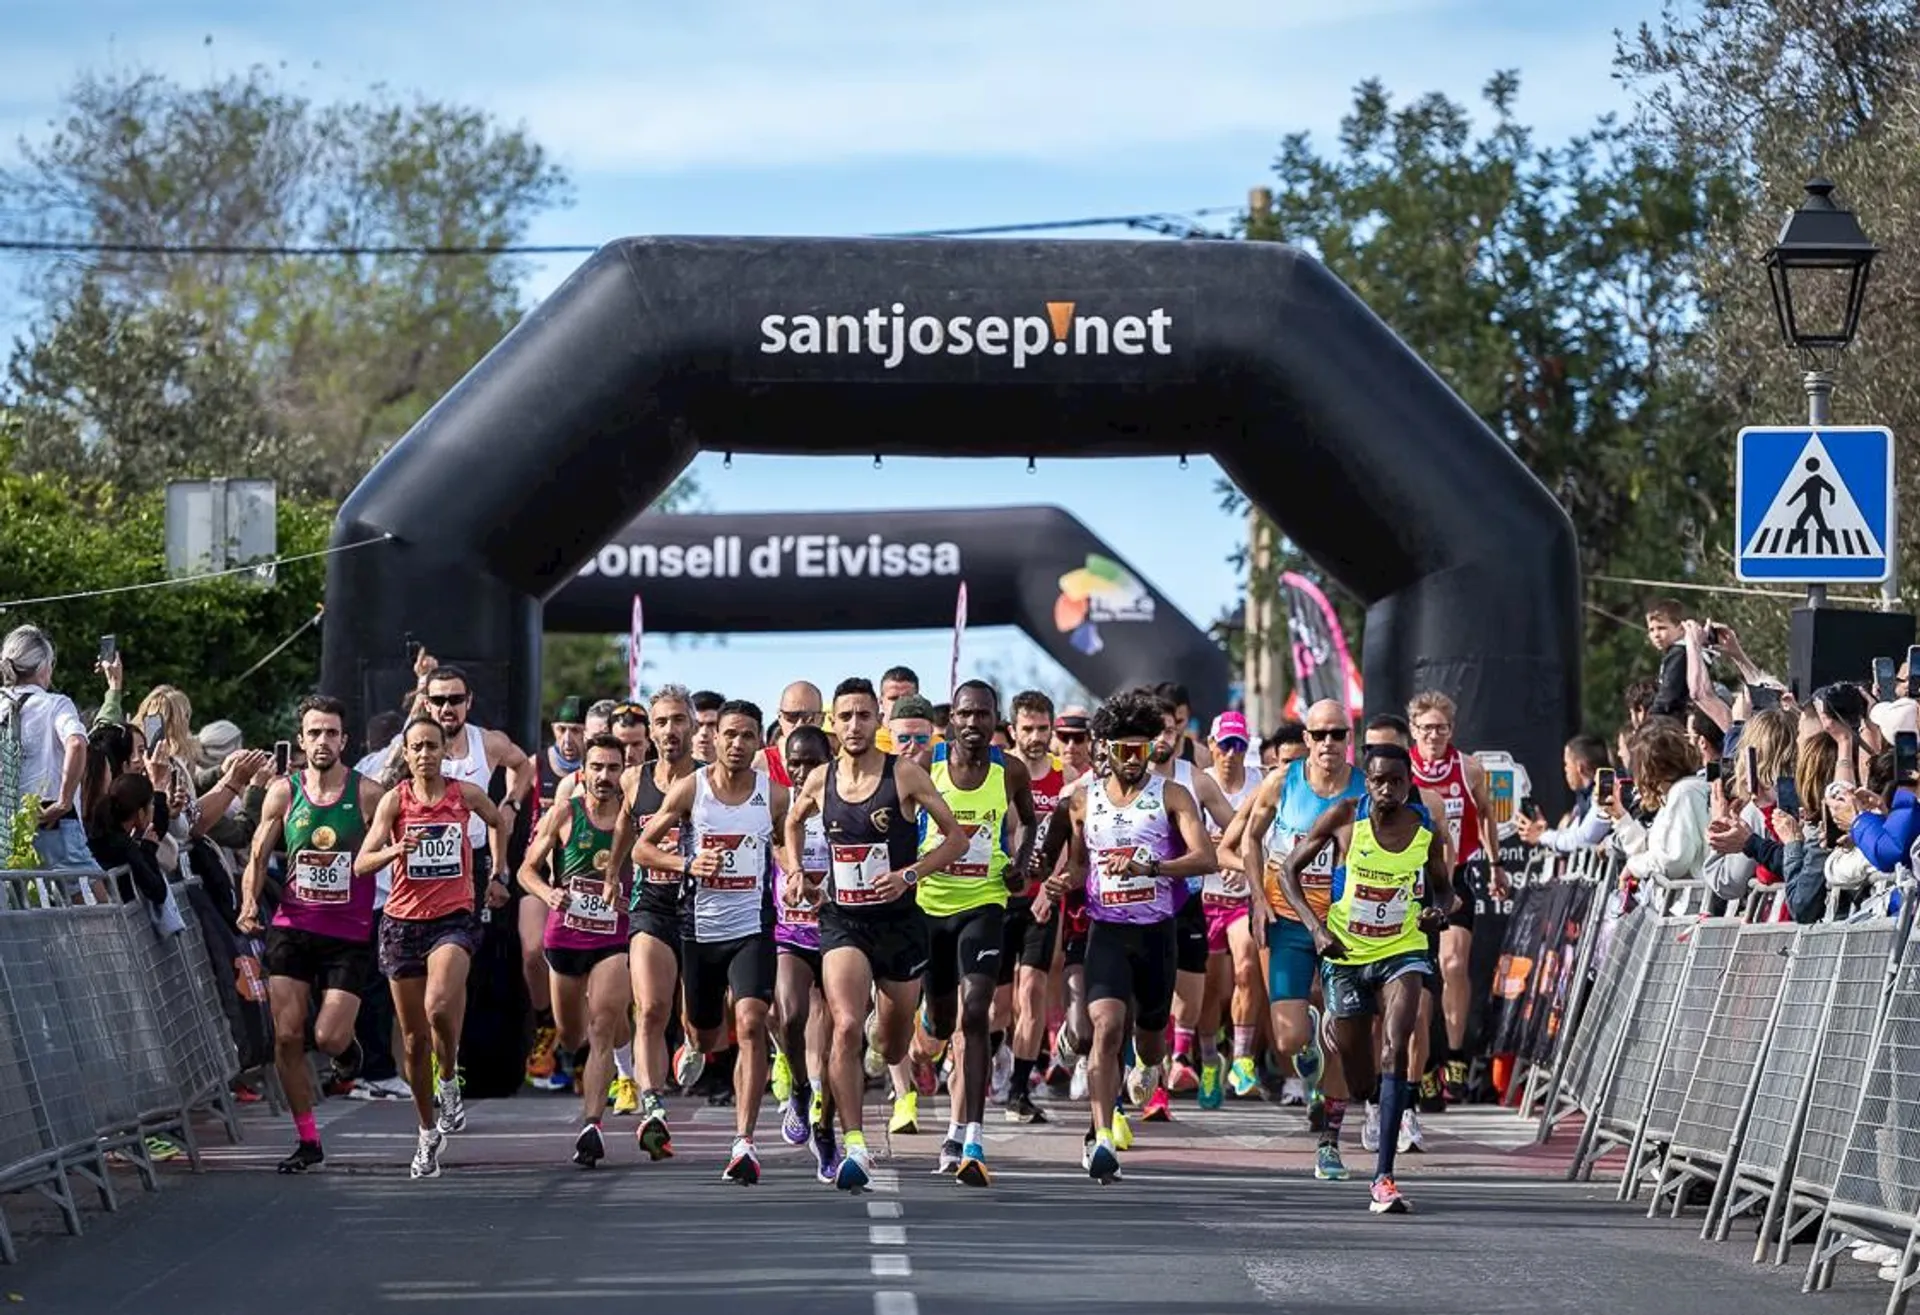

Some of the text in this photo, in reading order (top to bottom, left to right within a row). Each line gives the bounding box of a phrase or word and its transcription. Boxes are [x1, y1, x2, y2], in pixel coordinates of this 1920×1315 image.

[749, 534, 960, 578] d'Eivissa
[417, 840, 454, 858] 1002
[725, 851, 735, 868] 3
[309, 866, 338, 883] 386
[854, 863, 863, 881] 1
[580, 894, 608, 912] 384
[1376, 902, 1388, 919] 6
